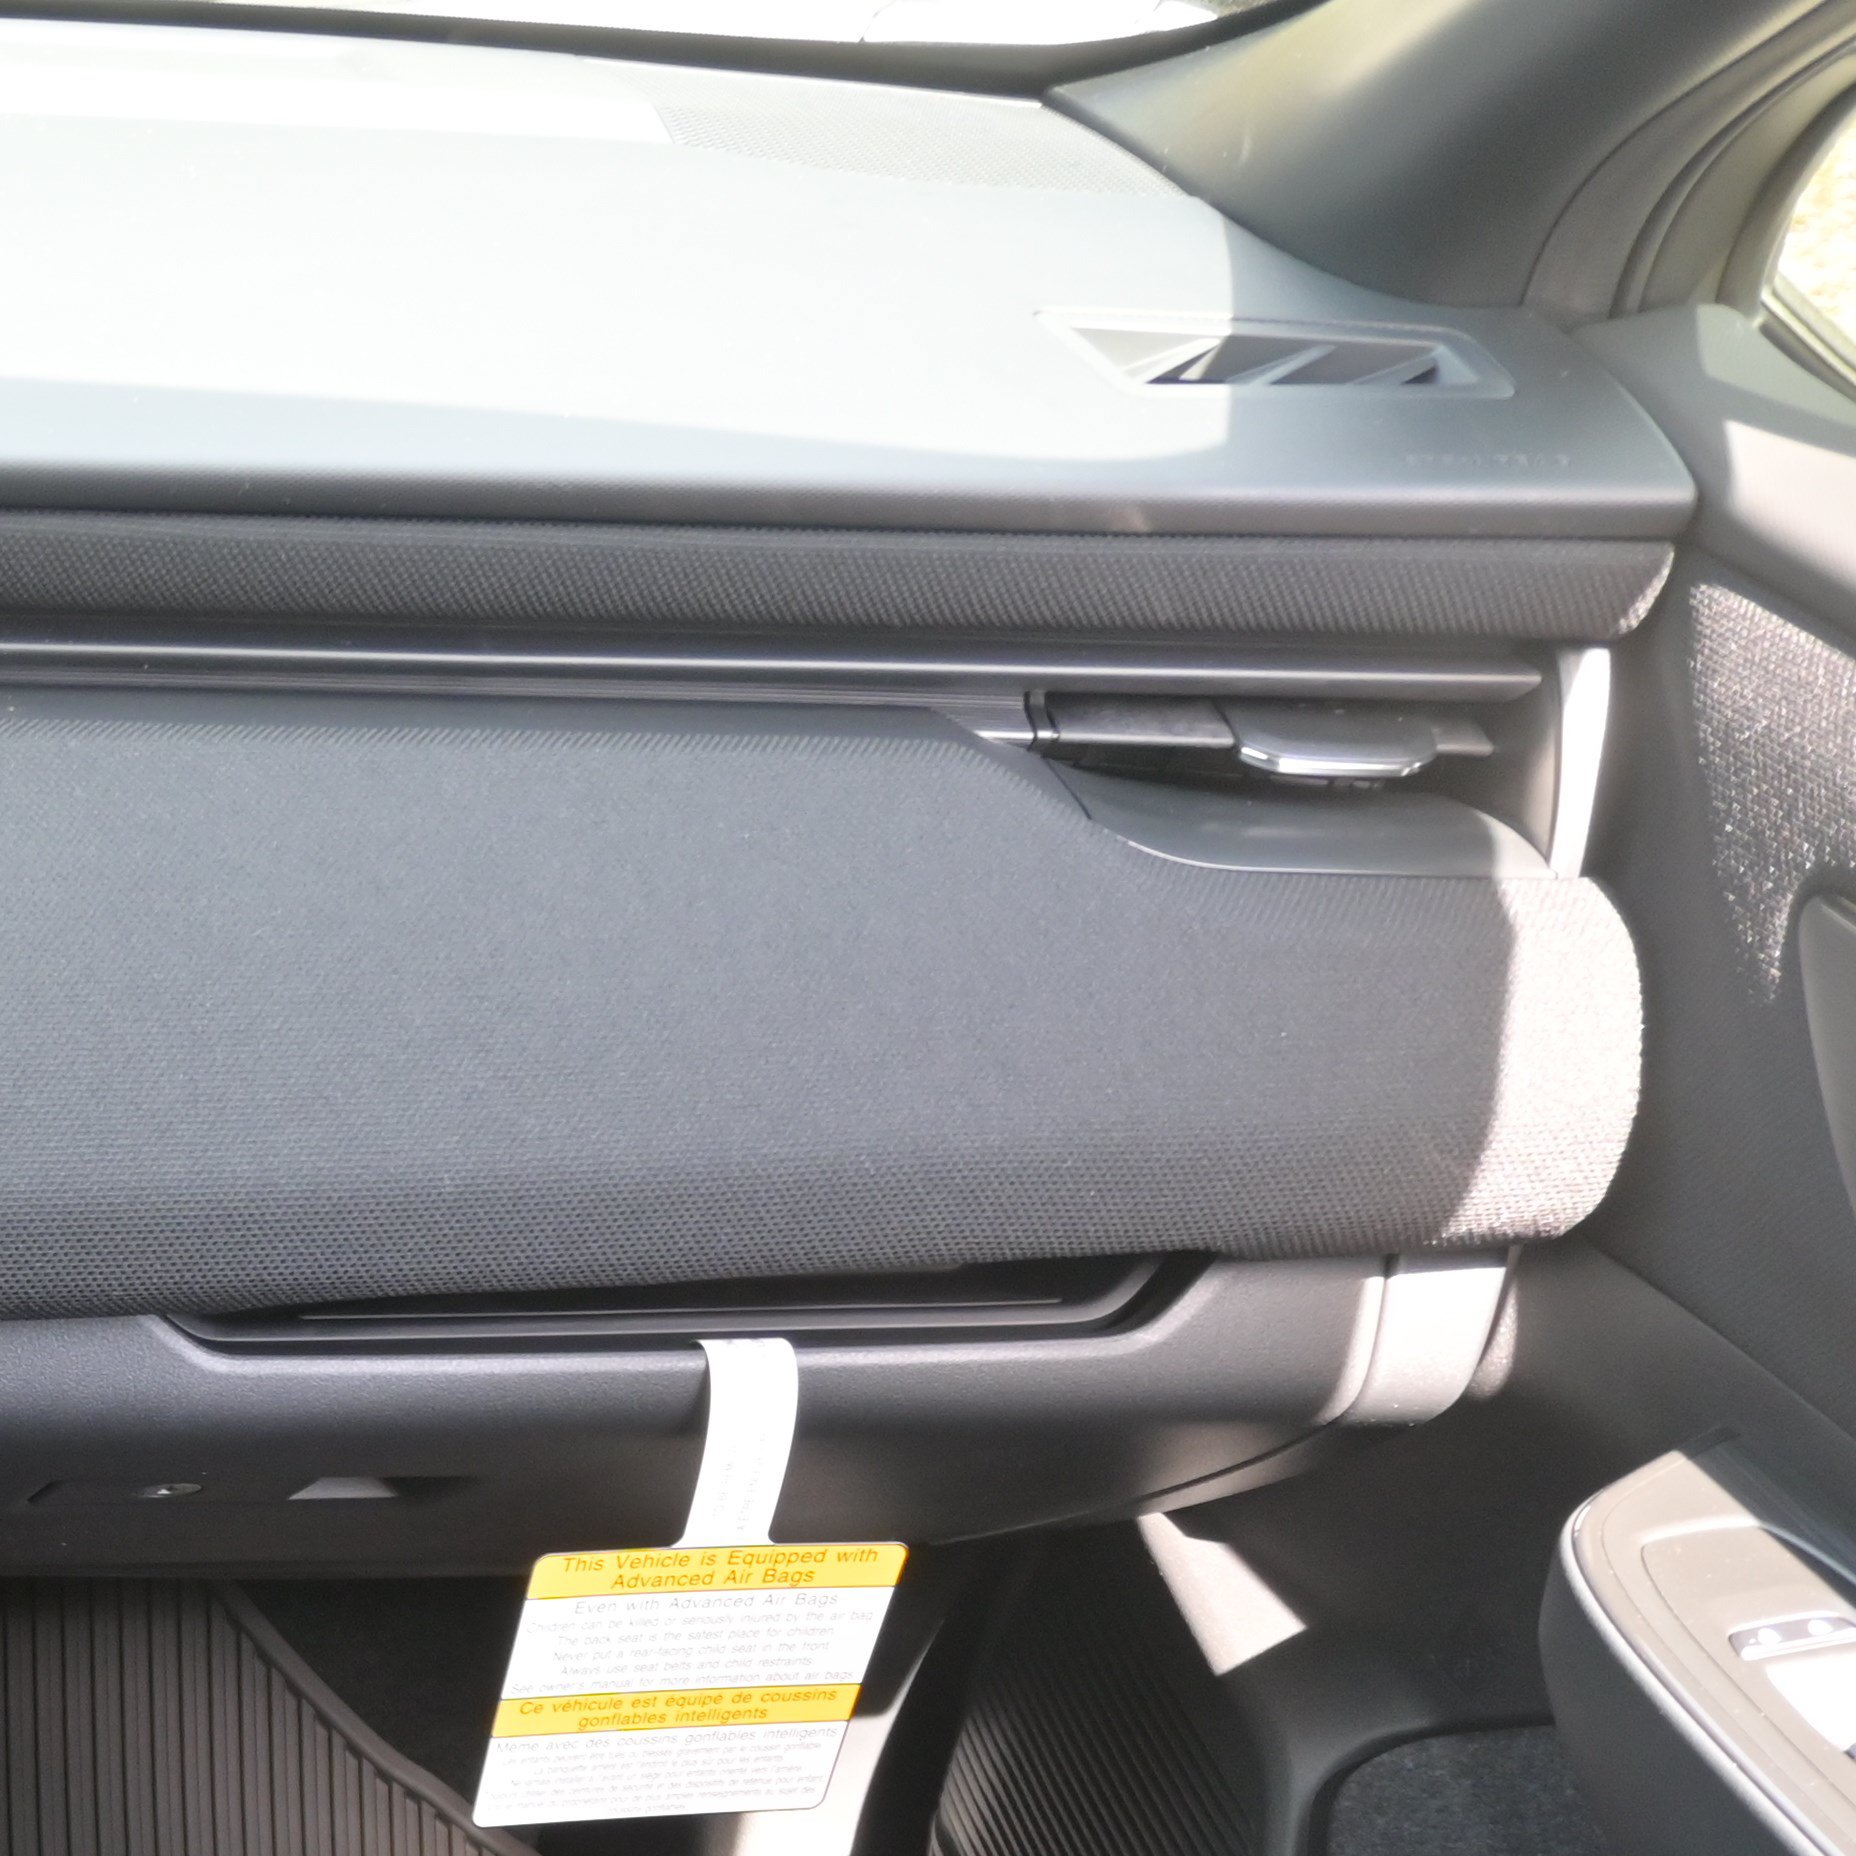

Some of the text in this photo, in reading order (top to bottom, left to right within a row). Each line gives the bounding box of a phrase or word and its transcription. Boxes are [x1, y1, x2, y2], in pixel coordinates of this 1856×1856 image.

[563, 1548, 877, 1571] This Vehicle is Equipped with
[611, 1567, 814, 1588] Advanced Air Bags
[574, 1592, 837, 1614] Even with Advanced Air Bags
